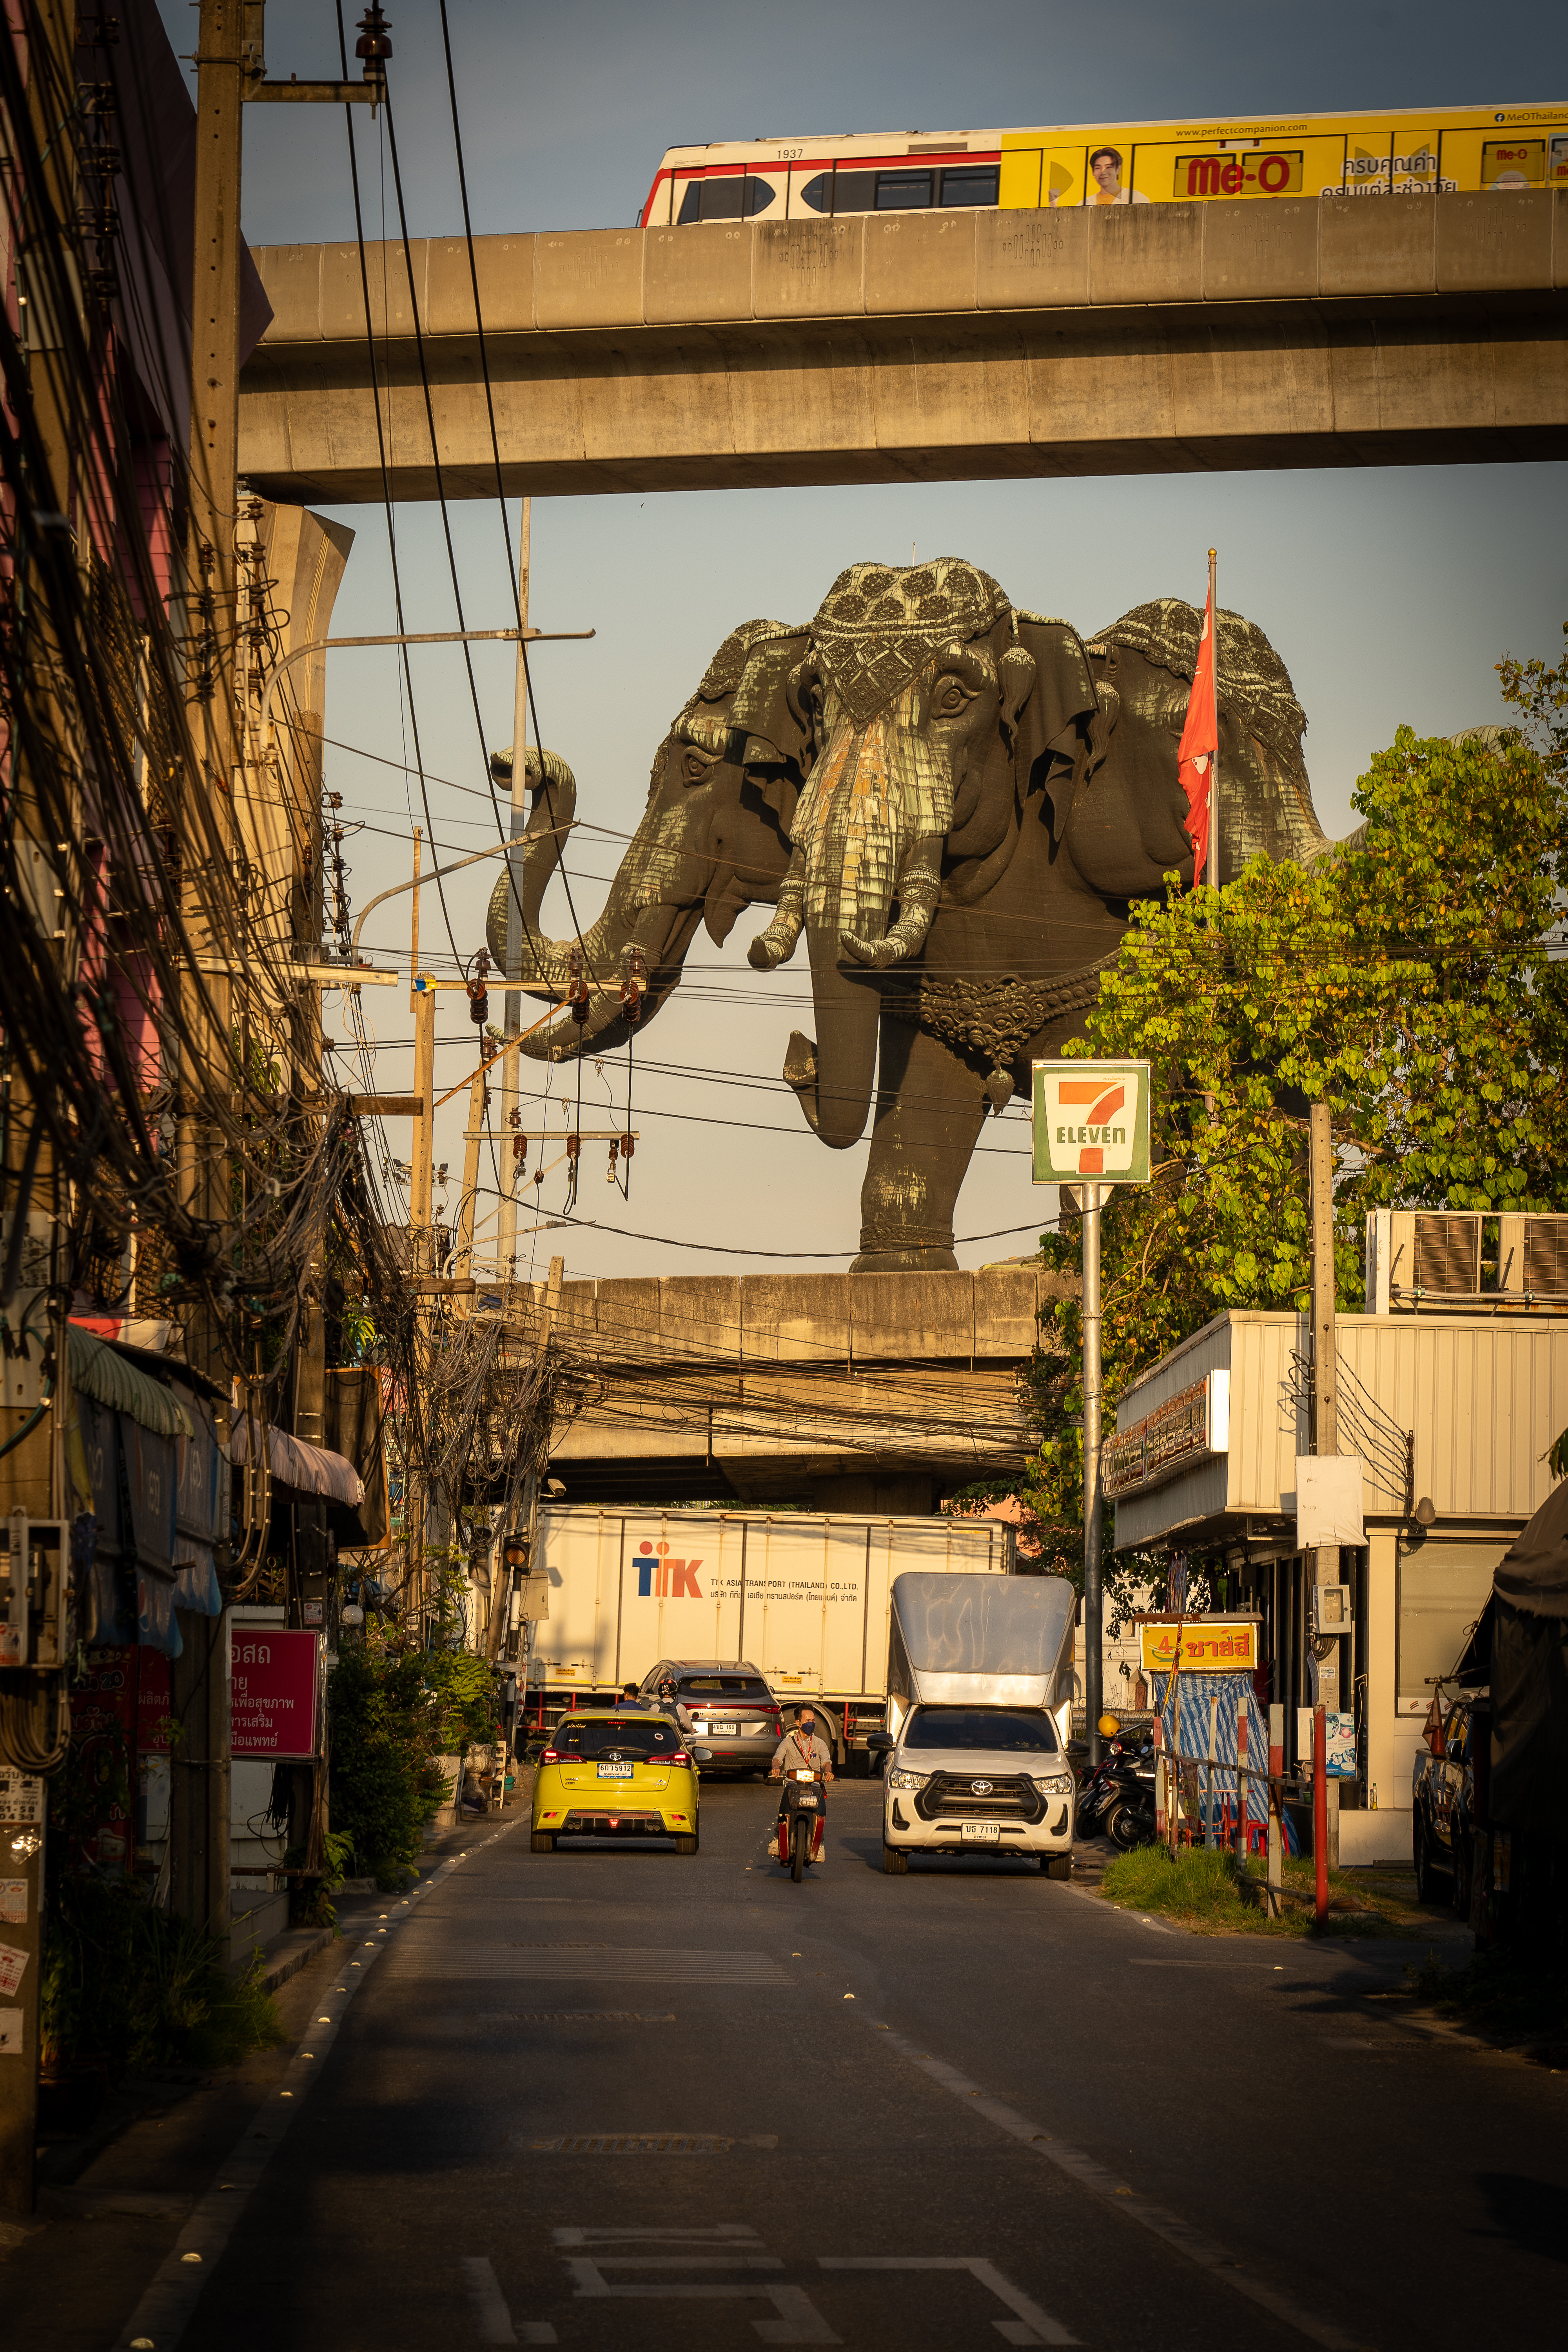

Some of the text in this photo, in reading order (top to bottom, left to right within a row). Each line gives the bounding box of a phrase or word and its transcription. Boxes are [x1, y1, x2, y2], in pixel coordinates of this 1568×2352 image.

[1176, 124, 1308, 137] www.perfectcompanion.com
[777, 149, 803, 159] 1937
[632, 1557, 704, 1598] TTK
[1158, 1636, 1172, 1653] 4
